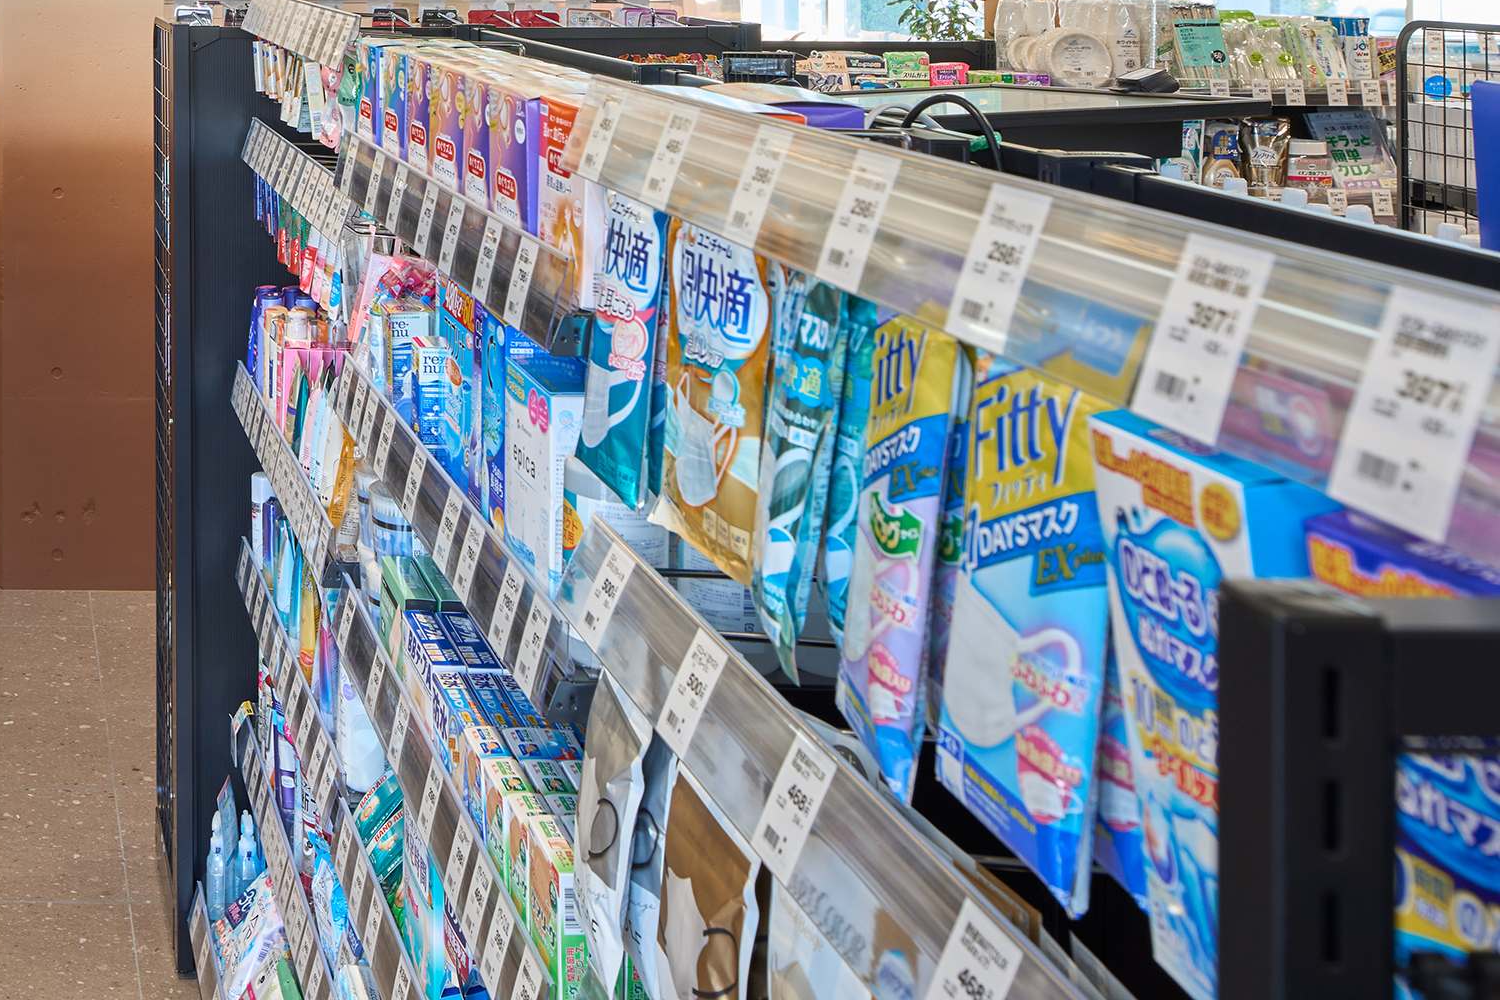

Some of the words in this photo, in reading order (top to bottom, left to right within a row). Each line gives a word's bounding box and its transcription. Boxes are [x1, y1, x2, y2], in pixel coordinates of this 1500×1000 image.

[1331, 149, 1362, 163] 簡単
[1337, 165, 1375, 177] クロス
[497, 174, 515, 192] めぐりズム
[513, 444, 536, 479] epica
[687, 672, 703, 698] 500
[359, 774, 388, 809] BAND-AID
